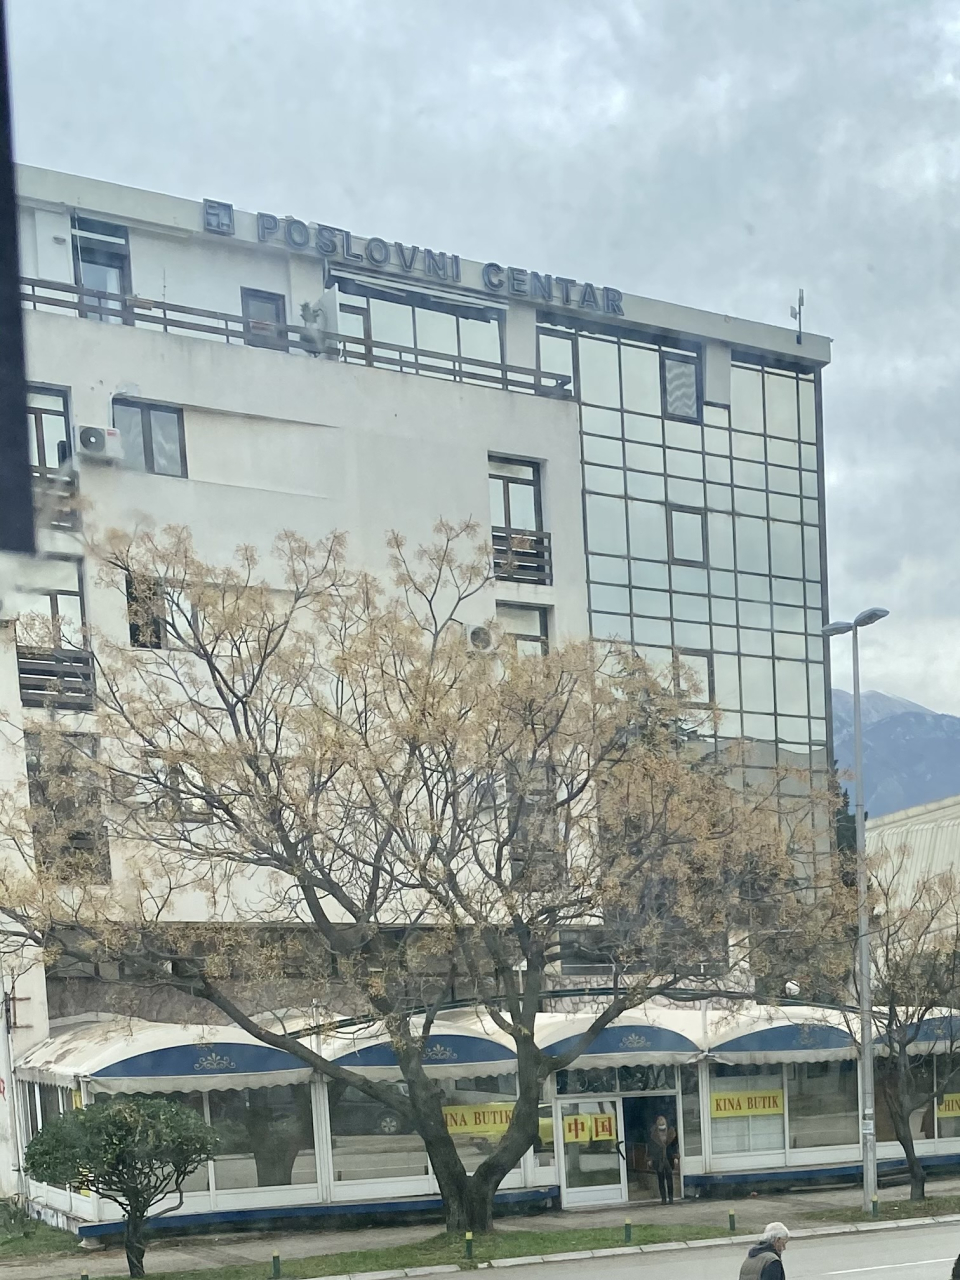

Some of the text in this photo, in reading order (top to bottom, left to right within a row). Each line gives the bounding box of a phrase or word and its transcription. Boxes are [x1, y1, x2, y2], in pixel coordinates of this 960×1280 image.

[256, 211, 625, 317] POSLOVNI CENTAR
[715, 1095, 779, 1112] KINA BUTIK
[444, 1109, 513, 1127] INA BUTIK
[567, 1116, 613, 1140] 中国
